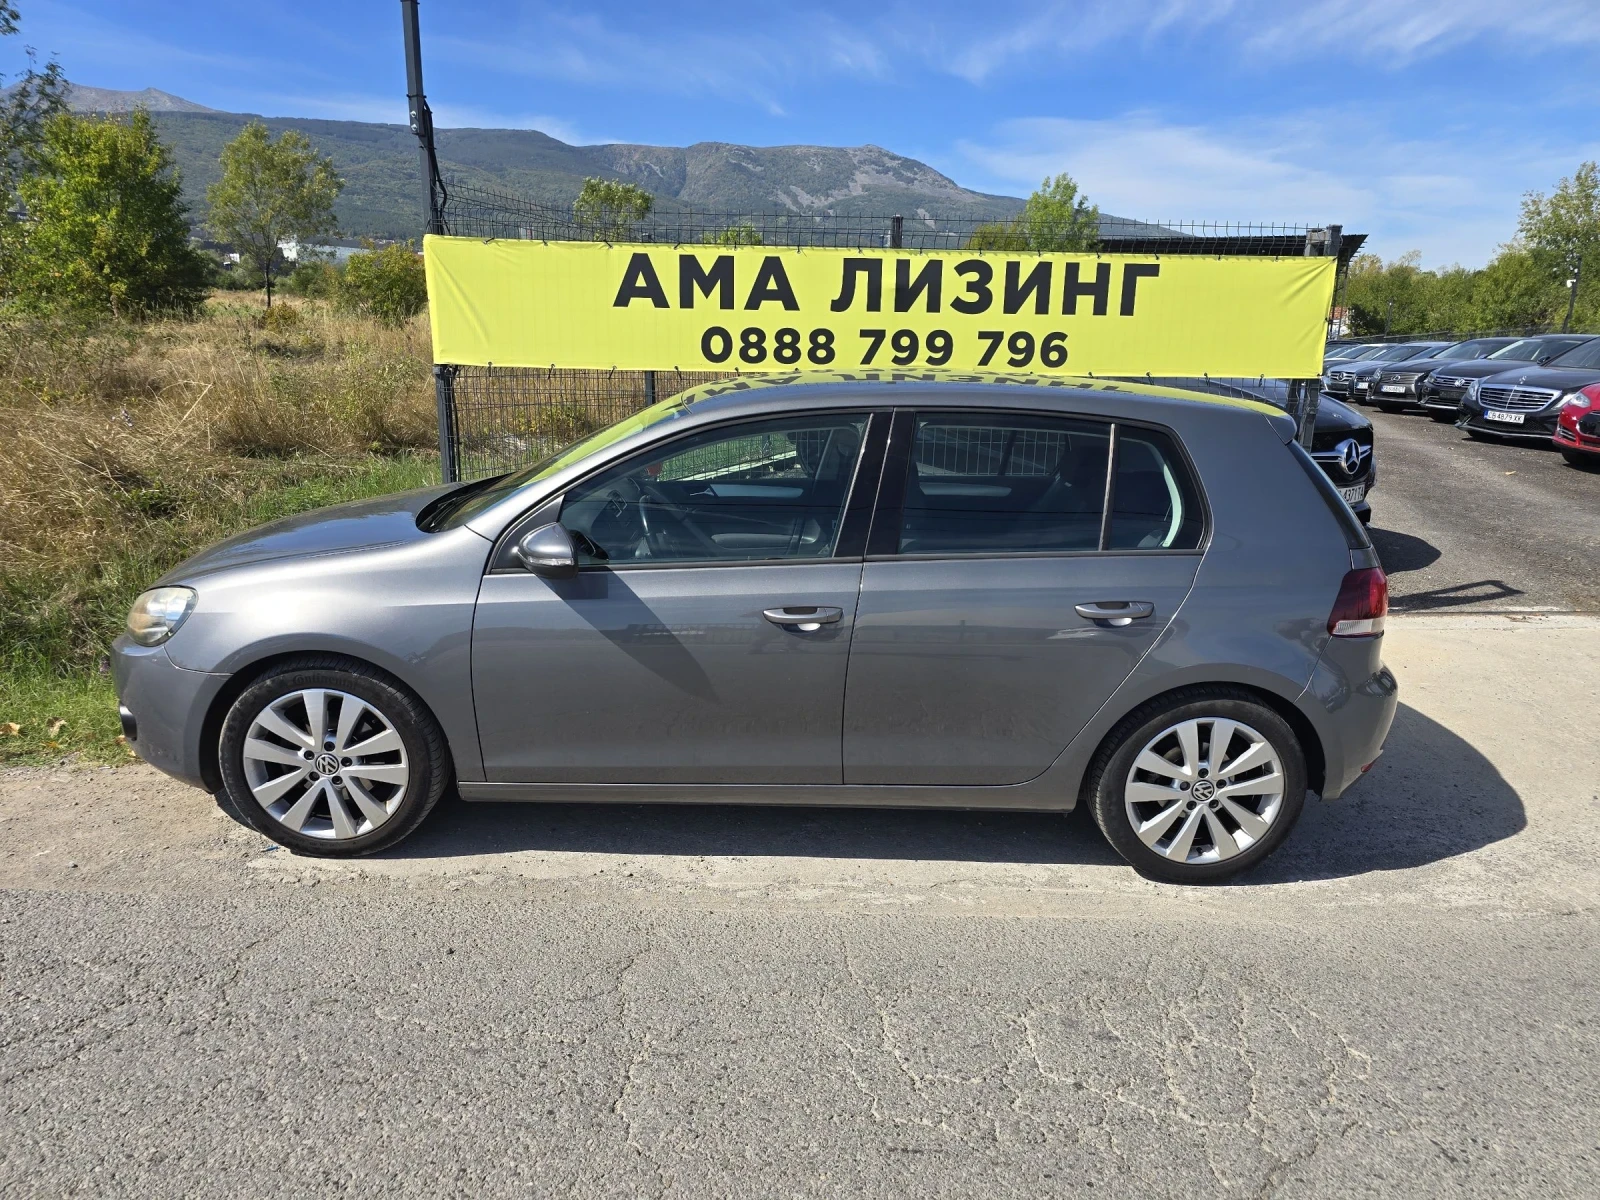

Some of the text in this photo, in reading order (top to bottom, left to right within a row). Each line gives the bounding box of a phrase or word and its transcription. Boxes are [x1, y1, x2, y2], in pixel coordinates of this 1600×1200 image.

[612, 252, 1161, 317] АМА ЛИЗИНГ
[700, 325, 1069, 369] 0888 799 796
[293, 674, 357, 690] Continental
